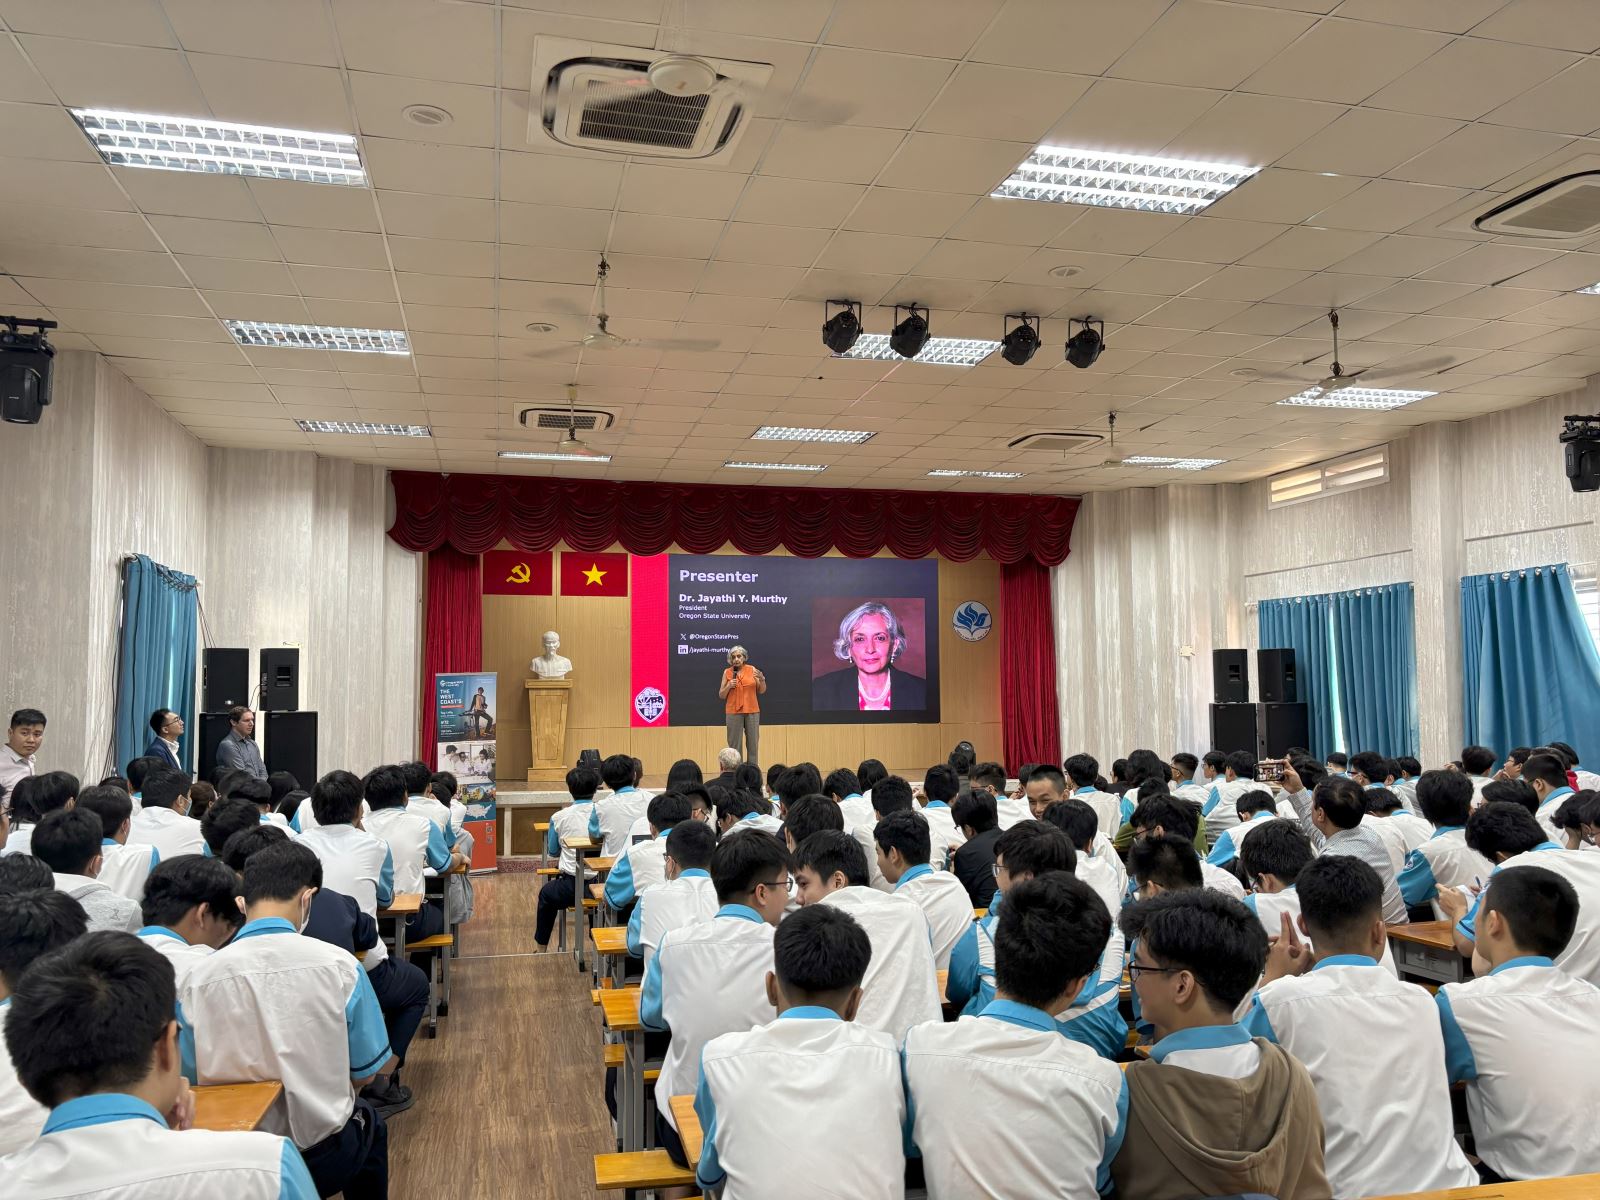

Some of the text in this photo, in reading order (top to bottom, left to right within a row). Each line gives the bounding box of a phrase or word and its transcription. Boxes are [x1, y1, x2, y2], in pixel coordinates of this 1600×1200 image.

[680, 570, 758, 582] Presenter
[679, 594, 788, 605] Dr. Jayathi Y. Murthy
